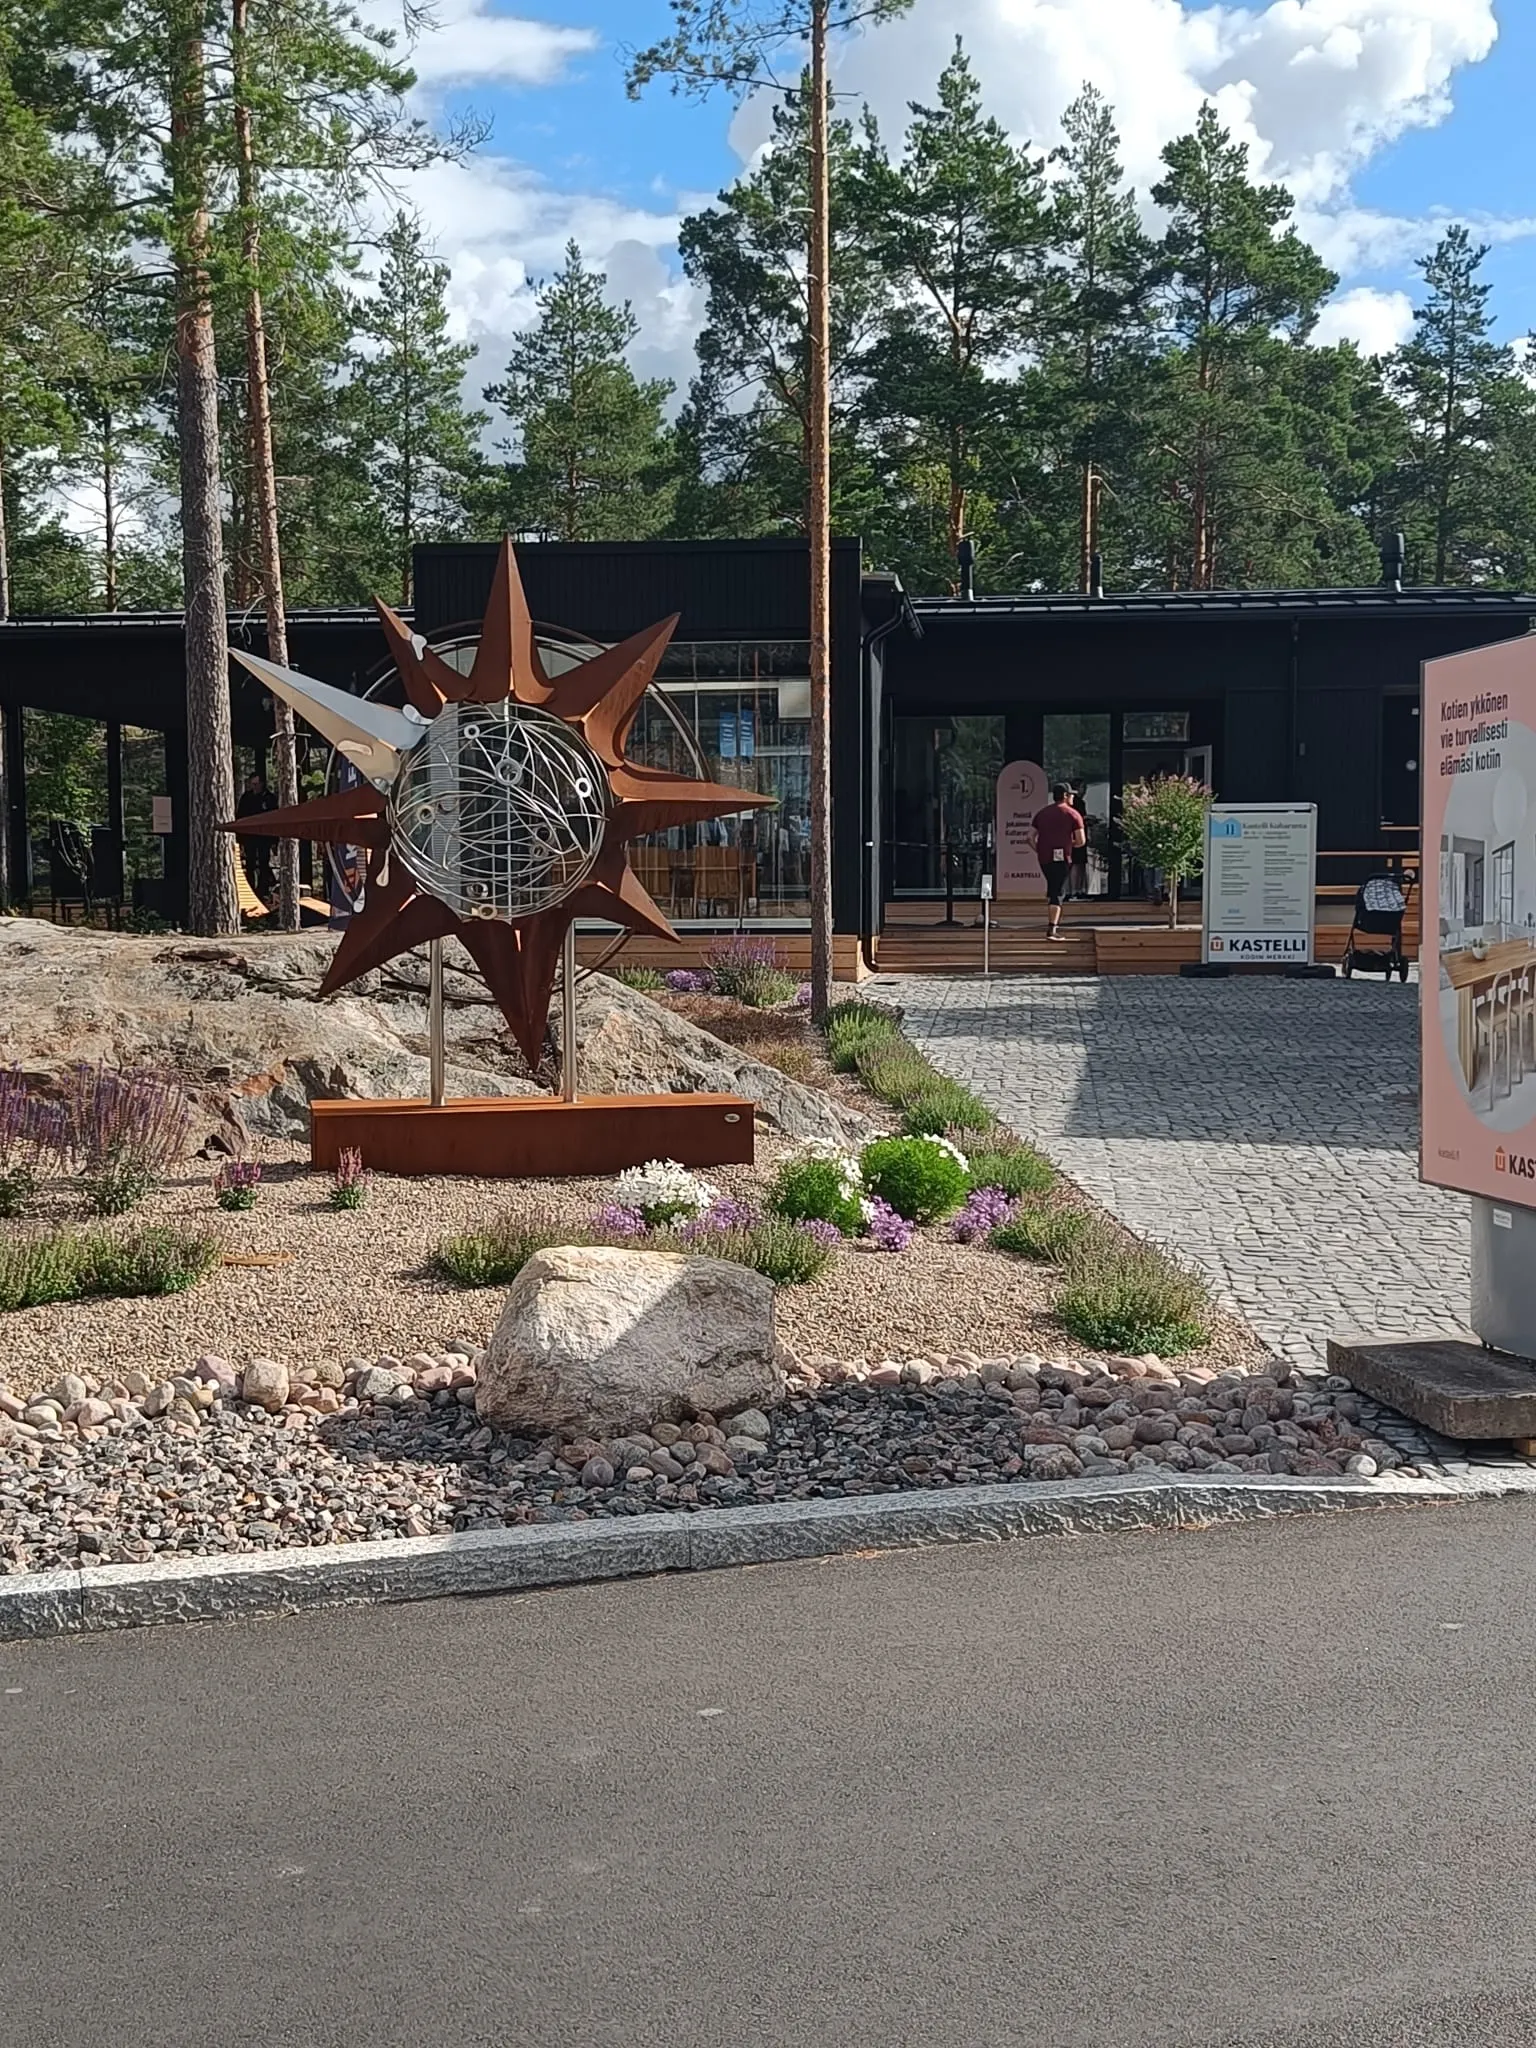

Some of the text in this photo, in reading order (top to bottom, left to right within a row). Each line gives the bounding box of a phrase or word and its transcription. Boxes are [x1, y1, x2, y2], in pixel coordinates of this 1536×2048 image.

[1441, 692, 1508, 721] Kotien ykkönen
[1441, 718, 1508, 748] vie turvallisesti
[1440, 748, 1501, 776] elämäsi kotiin
[1229, 939, 1306, 951] KASTELLI
[1509, 1154, 1536, 1179] KAS
